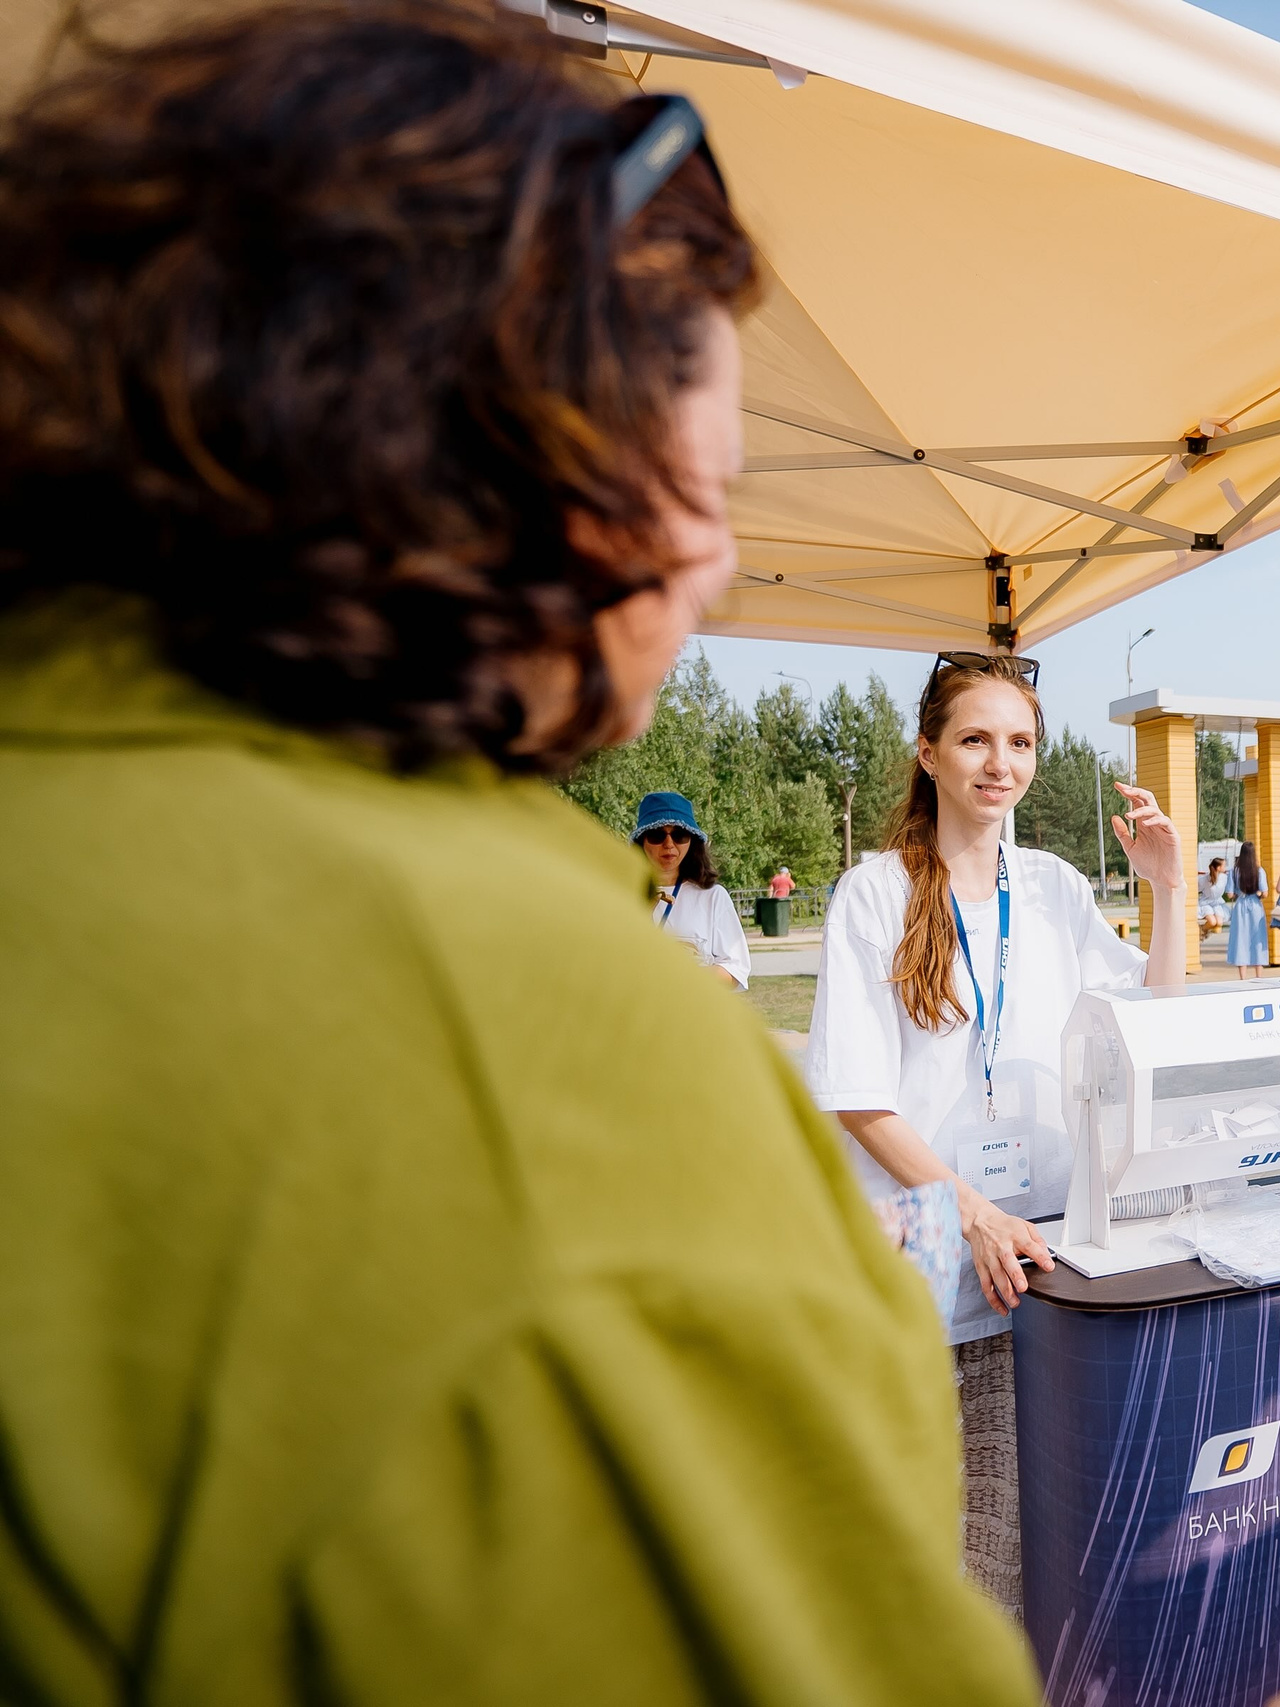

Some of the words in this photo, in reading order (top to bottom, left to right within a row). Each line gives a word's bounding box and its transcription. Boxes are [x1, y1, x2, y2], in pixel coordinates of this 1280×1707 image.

[1001, 937, 1009, 966] СНГБ
[1249, 1030, 1275, 1041] БАНК
[991, 1142, 1009, 1150] СНГБ
[984, 1165, 1007, 1176] Елена
[1188, 1502, 1257, 1540] БАНК
